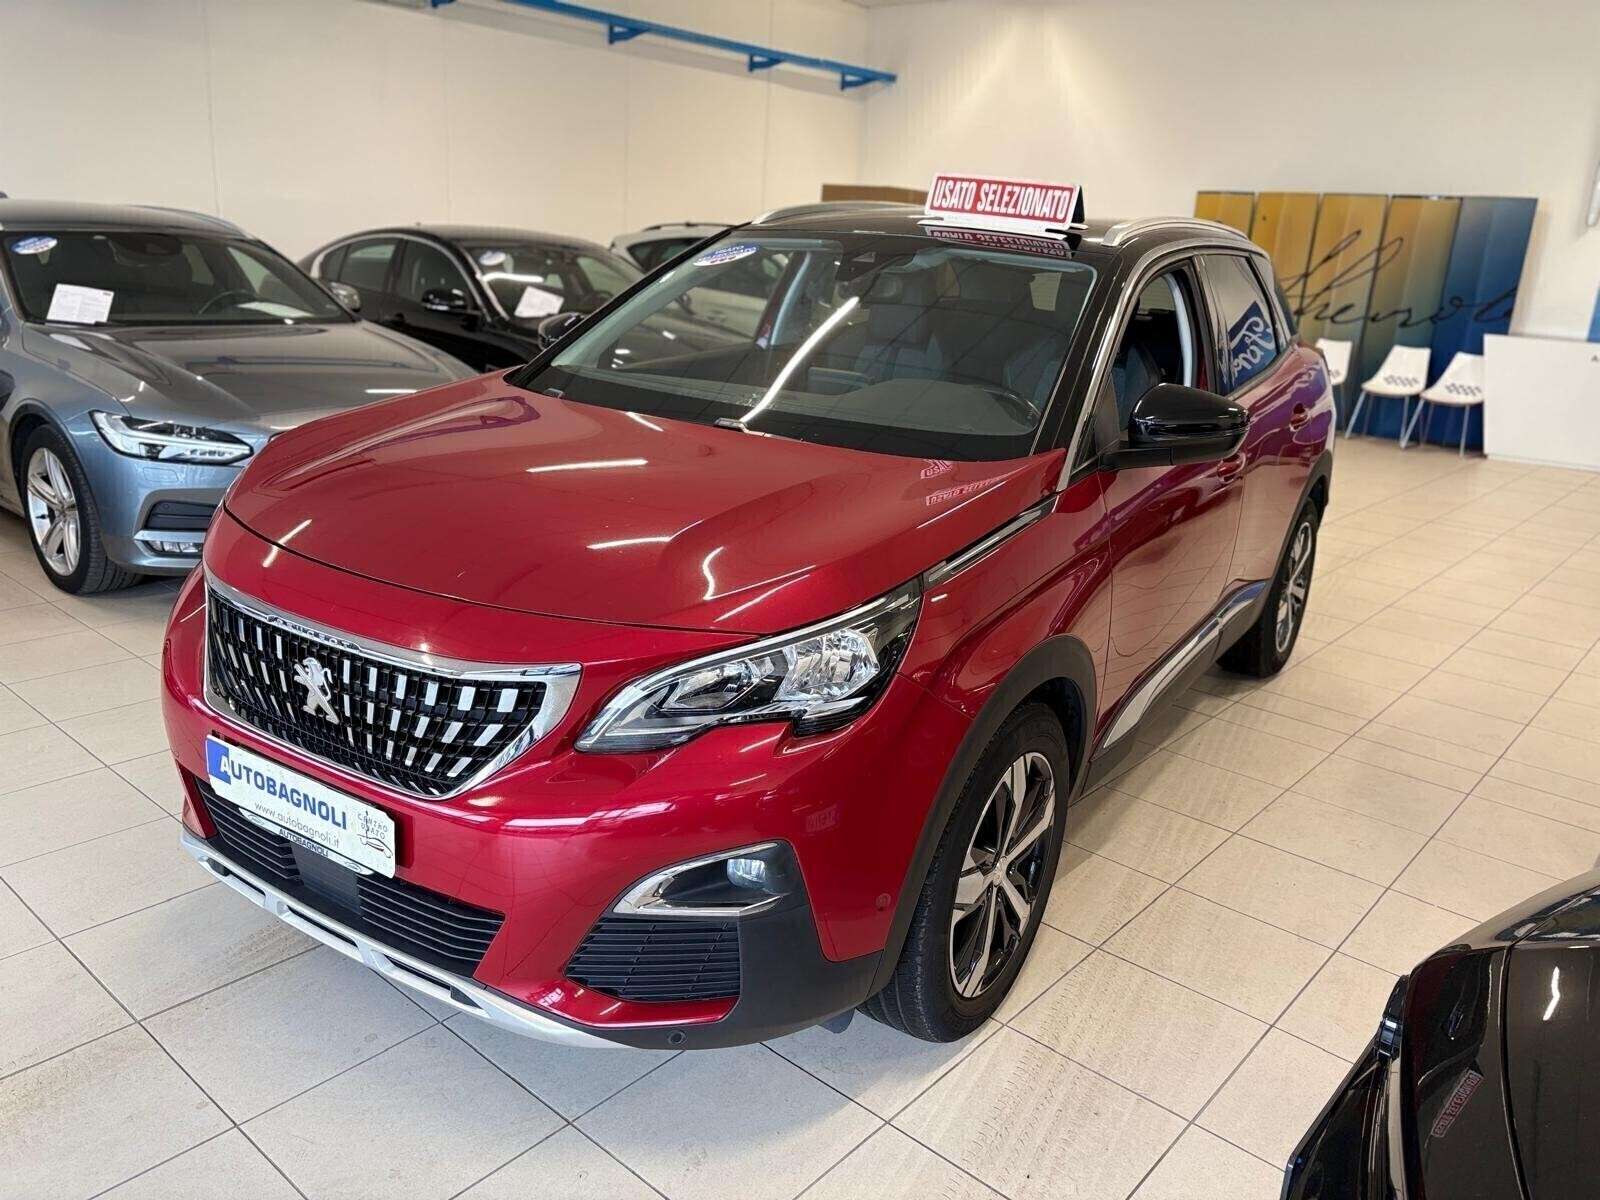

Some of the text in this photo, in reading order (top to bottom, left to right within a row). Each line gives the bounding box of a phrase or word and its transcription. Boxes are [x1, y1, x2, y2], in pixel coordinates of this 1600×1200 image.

[931, 178, 1071, 220] USATO SELEZIONATO
[219, 755, 348, 830] AUTOBAGNOLI
[254, 801, 341, 849] www.autobagnoli.it
[278, 828, 330, 858] AUTOBAGNOLI
